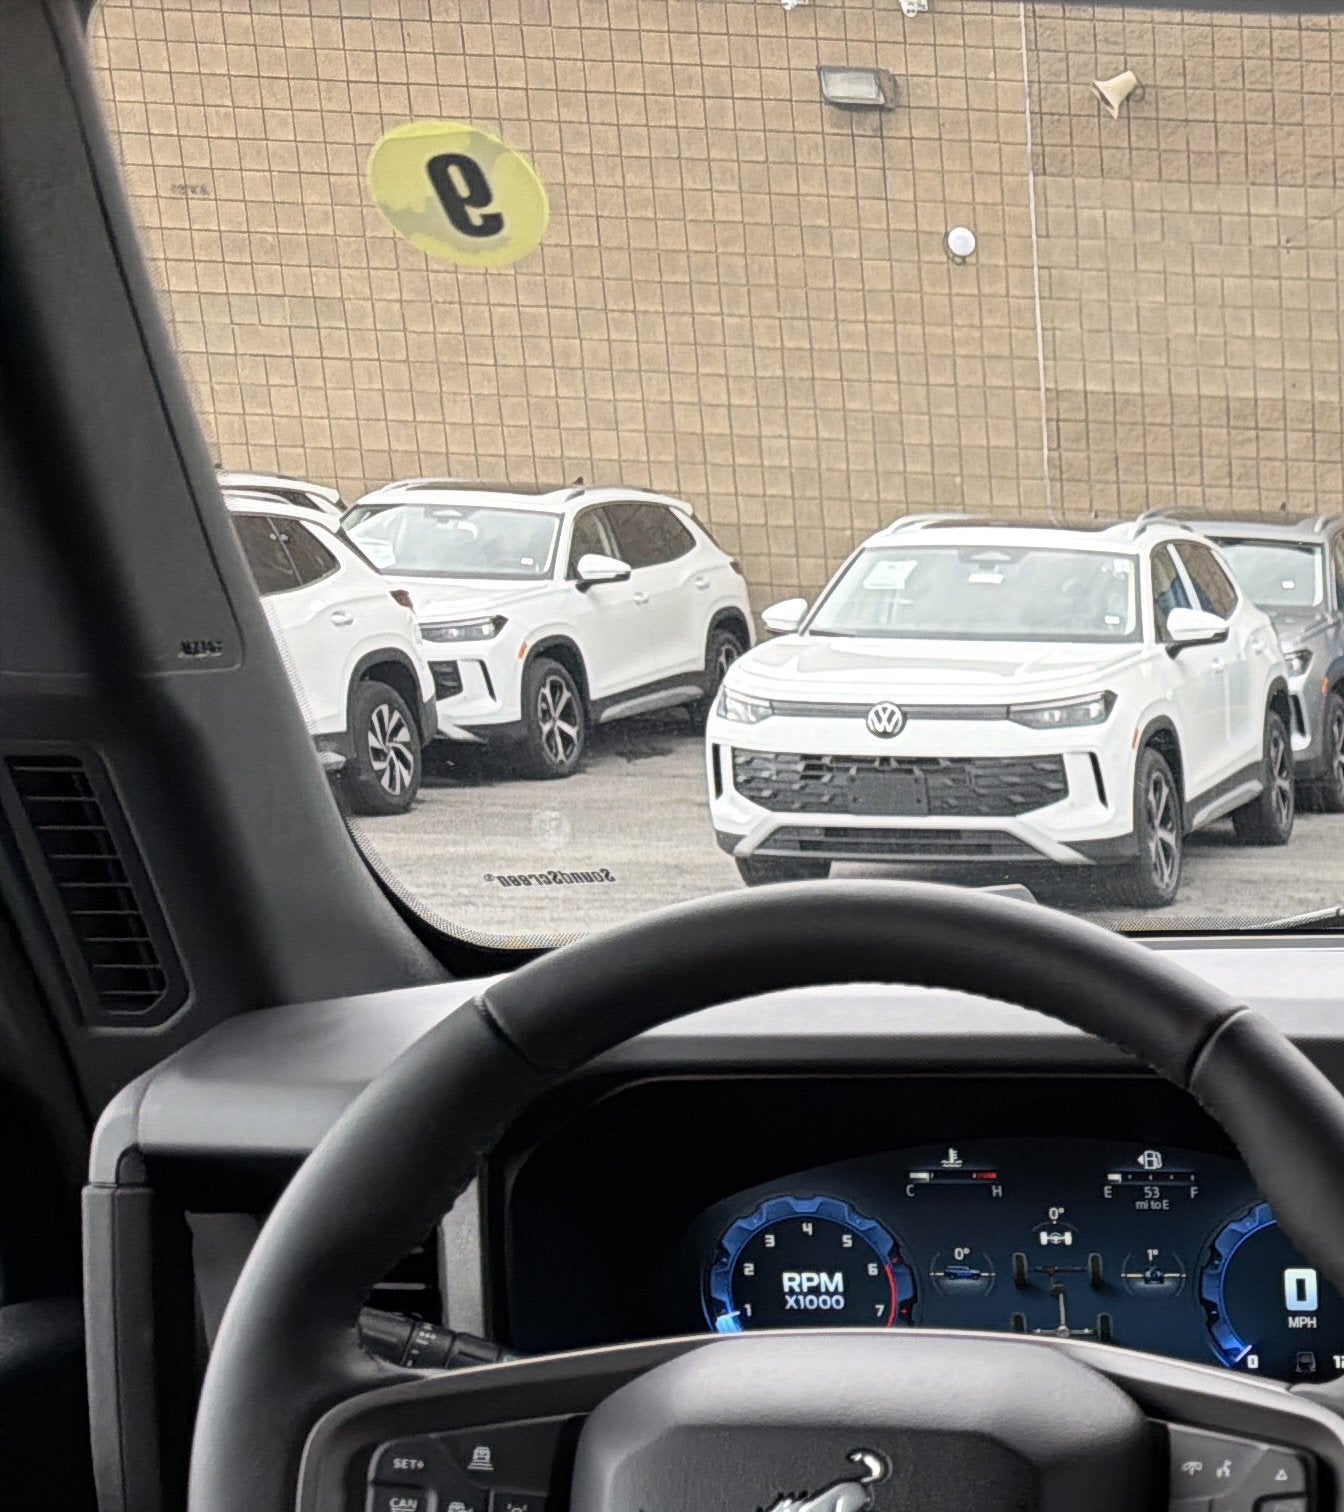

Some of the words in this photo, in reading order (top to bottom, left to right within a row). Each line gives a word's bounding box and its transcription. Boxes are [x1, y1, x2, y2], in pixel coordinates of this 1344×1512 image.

[906, 1184, 916, 1198] C
[991, 1184, 1003, 1198] H
[1103, 1185, 1113, 1200] E
[1143, 1185, 1161, 1200] 53
[1190, 1185, 1199, 1200] F
[1135, 1200, 1148, 1210] mi
[1150, 1200, 1161, 1210] to
[802, 1222, 813, 1237] 4
[764, 1234, 776, 1248] 3
[842, 1234, 853, 1248] 5
[743, 1263, 755, 1276] 2
[867, 1263, 879, 1276] 6
[782, 1272, 844, 1294] RPM
[1284, 1267, 1318, 1312] 0
[785, 1294, 845, 1311] X1000
[743, 1304, 753, 1318] 1
[875, 1304, 886, 1318] 7
[1287, 1315, 1318, 1330] MPH
[1246, 1355, 1259, 1369] 0
[389, 1497, 417, 1509] CAN
